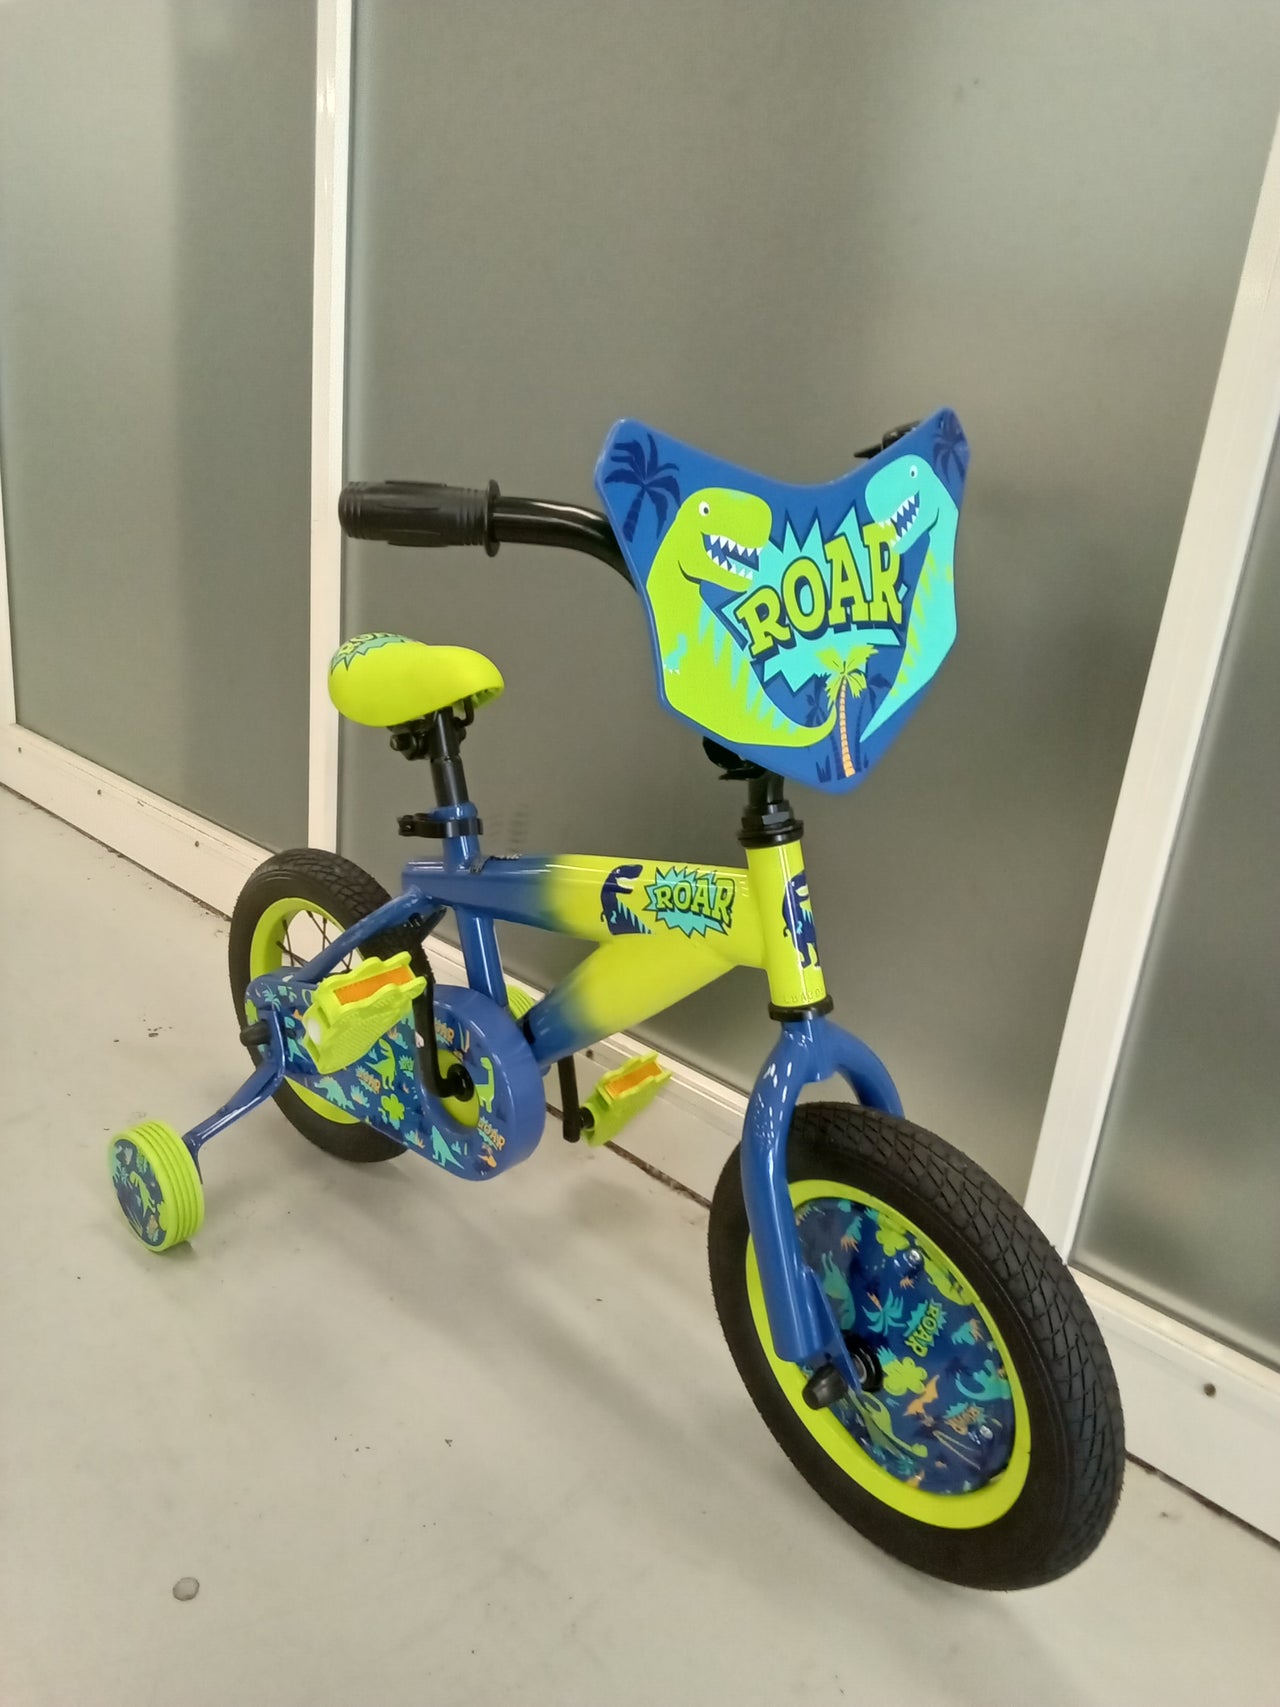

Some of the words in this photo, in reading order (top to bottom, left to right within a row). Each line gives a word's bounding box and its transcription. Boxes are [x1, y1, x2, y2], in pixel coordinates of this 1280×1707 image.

[733, 521, 903, 661] ROAR
[653, 877, 735, 927] ROAR
[904, 1303, 939, 1358] ROAR
